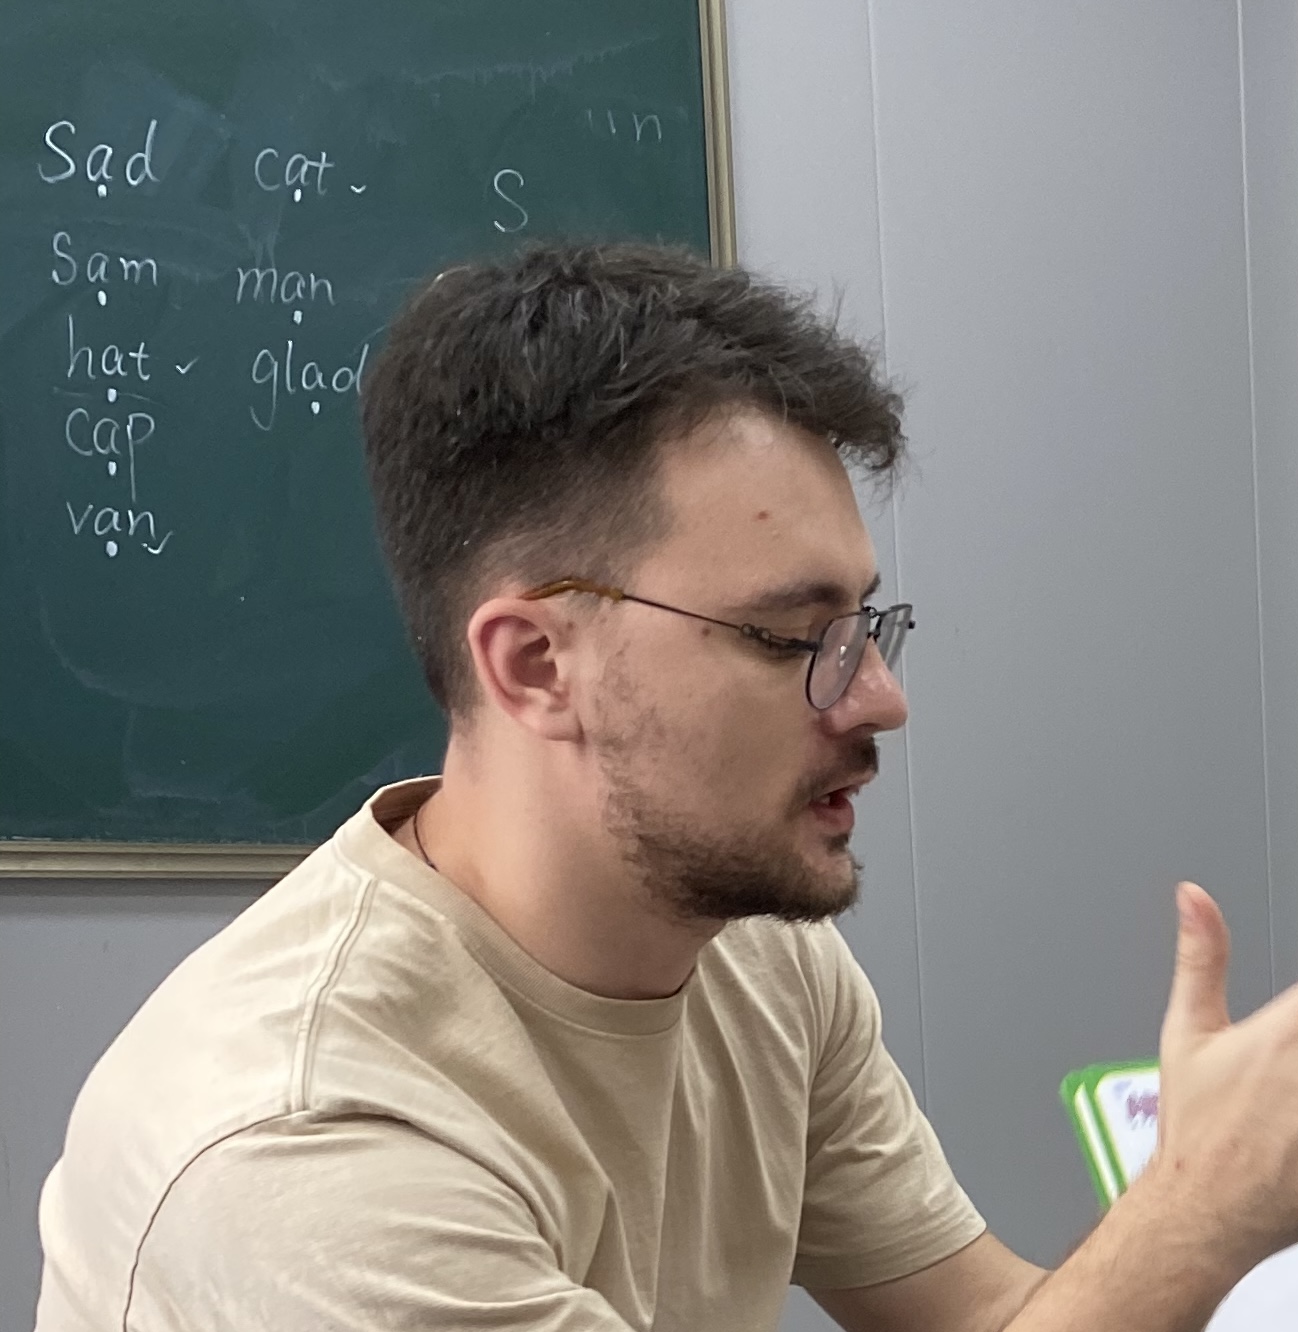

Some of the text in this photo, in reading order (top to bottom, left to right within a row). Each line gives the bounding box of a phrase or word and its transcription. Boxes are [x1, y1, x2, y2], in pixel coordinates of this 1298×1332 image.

[38, 119, 159, 186] Sad
[255, 147, 335, 195] cat
[493, 168, 529, 233] S
[52, 231, 158, 286] Sam
[237, 266, 336, 306] man
[67, 314, 151, 381] hat
[250, 339, 370, 431] glad
[65, 407, 156, 502] cap
[66, 502, 157, 541] van
